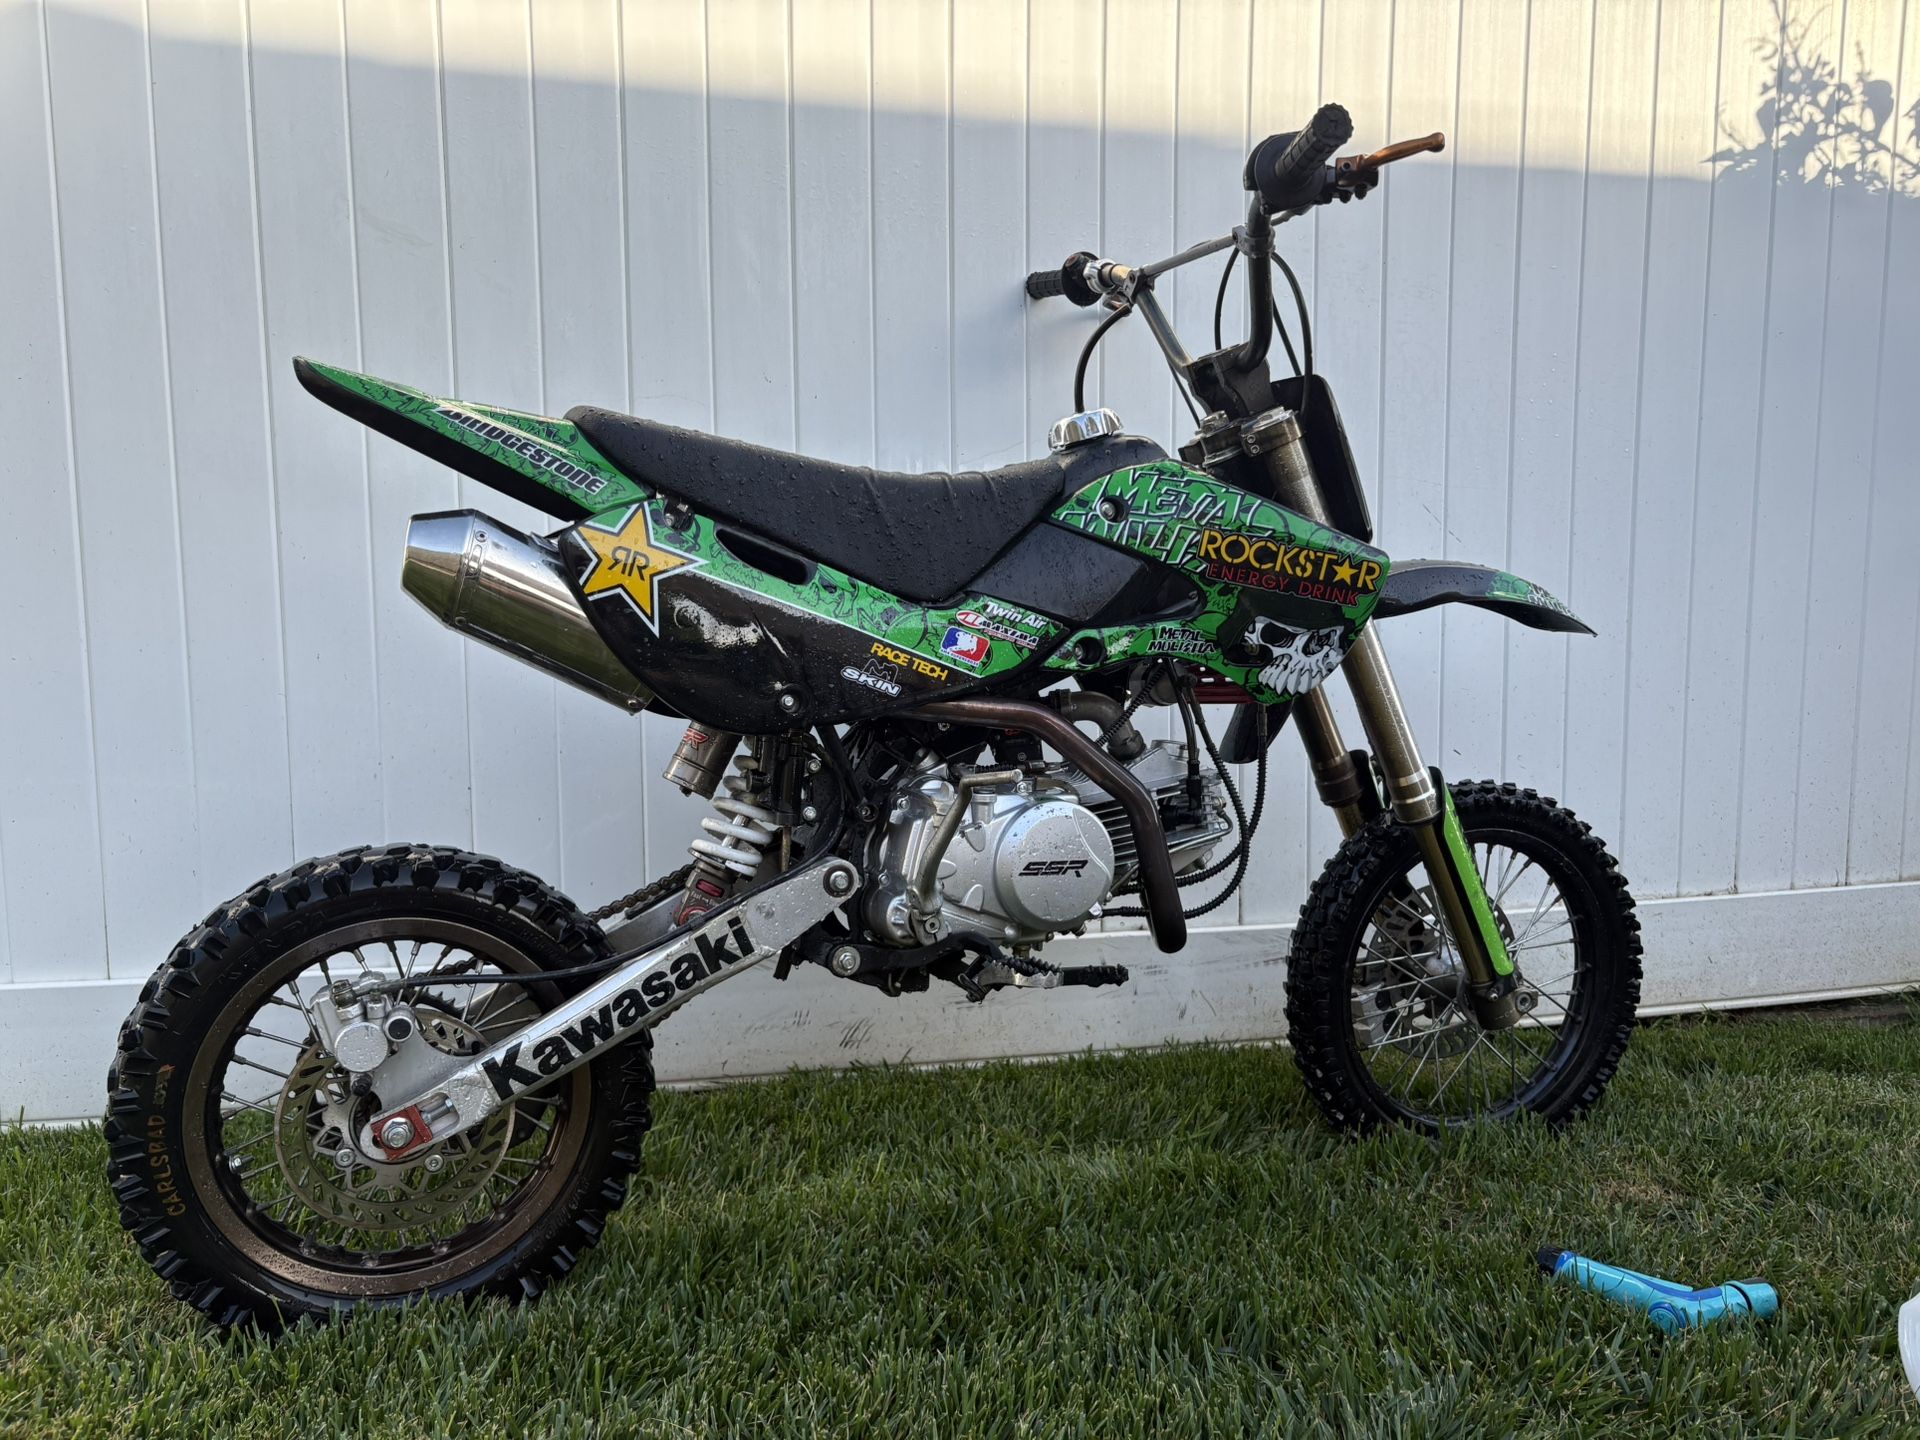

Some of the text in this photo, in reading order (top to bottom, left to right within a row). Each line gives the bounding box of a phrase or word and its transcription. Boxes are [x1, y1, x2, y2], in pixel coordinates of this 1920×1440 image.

[433, 407, 607, 495] BRIDGESTONE
[1209, 563, 1359, 606] ENERGY DRINK
[985, 601, 1047, 629] Twin Air
[1159, 625, 1205, 641] METAL
[870, 642, 948, 681] RACE TECH
[841, 666, 901, 697] SKIN
[1018, 860, 1089, 878] SSR
[481, 916, 755, 1100] Kawasaki
[147, 1114, 187, 1217] CARLSBAD
